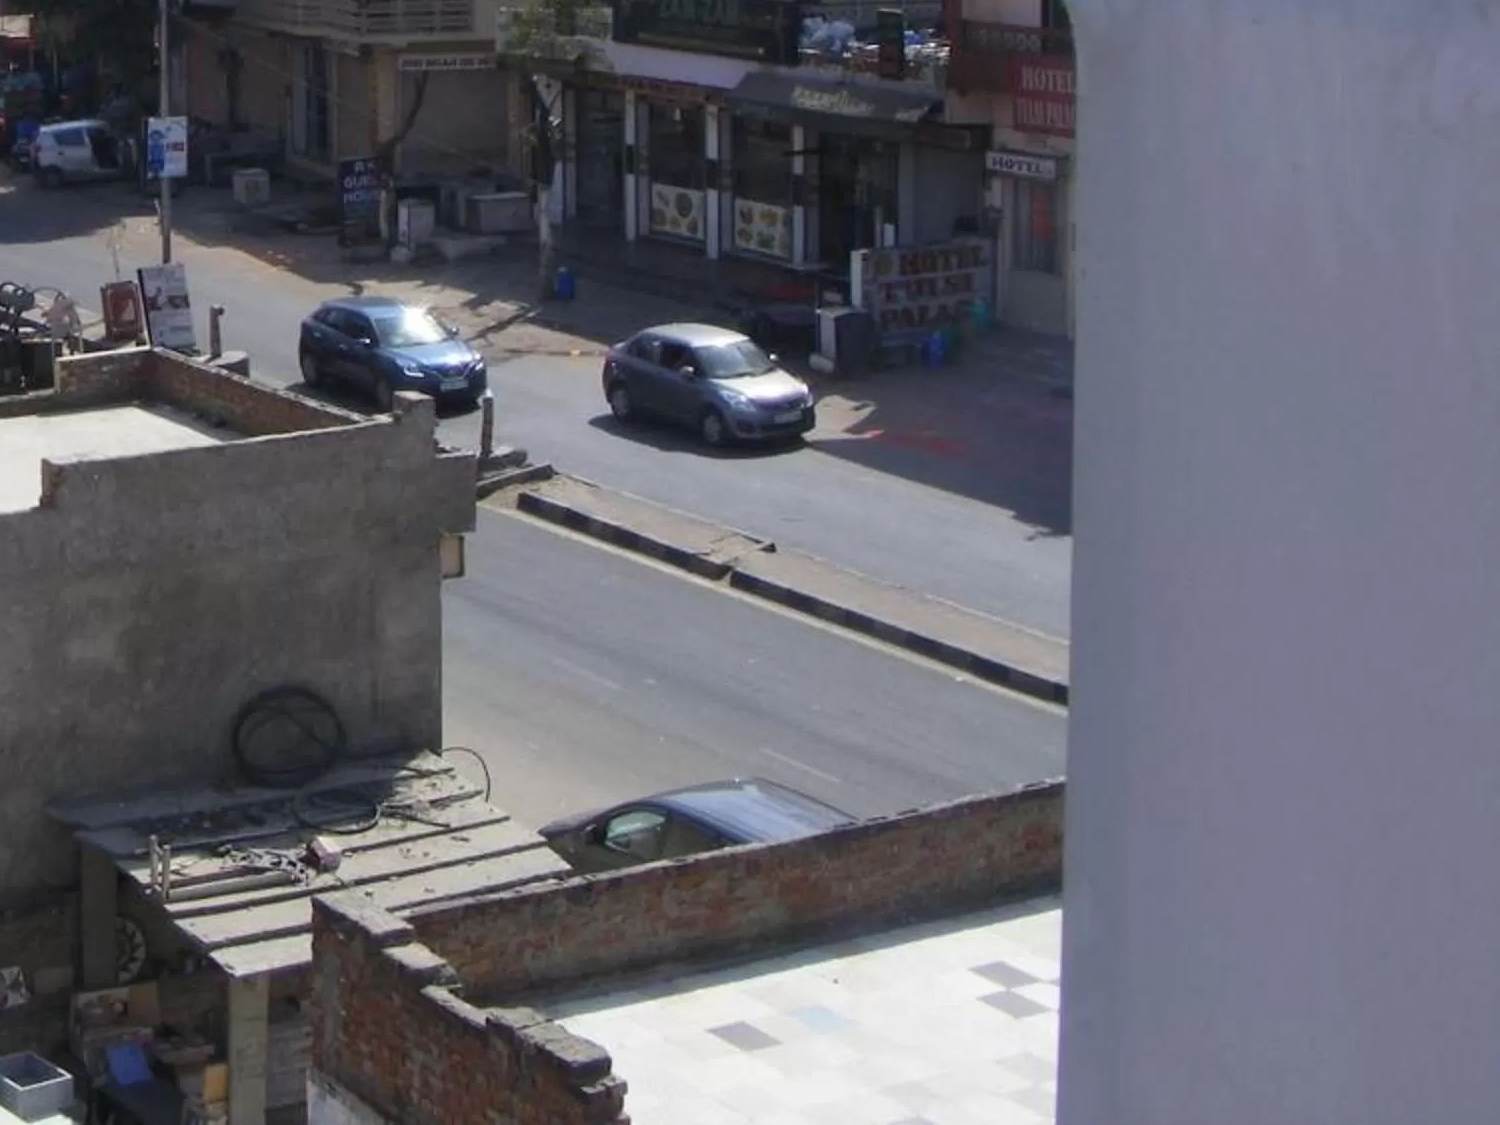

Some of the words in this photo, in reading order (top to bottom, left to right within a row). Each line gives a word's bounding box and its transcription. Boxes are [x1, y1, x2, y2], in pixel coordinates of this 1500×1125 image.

[1021, 65, 1074, 93] HOTEL
[991, 156, 1044, 172] HOTEL
[899, 246, 989, 275] HOTEL
